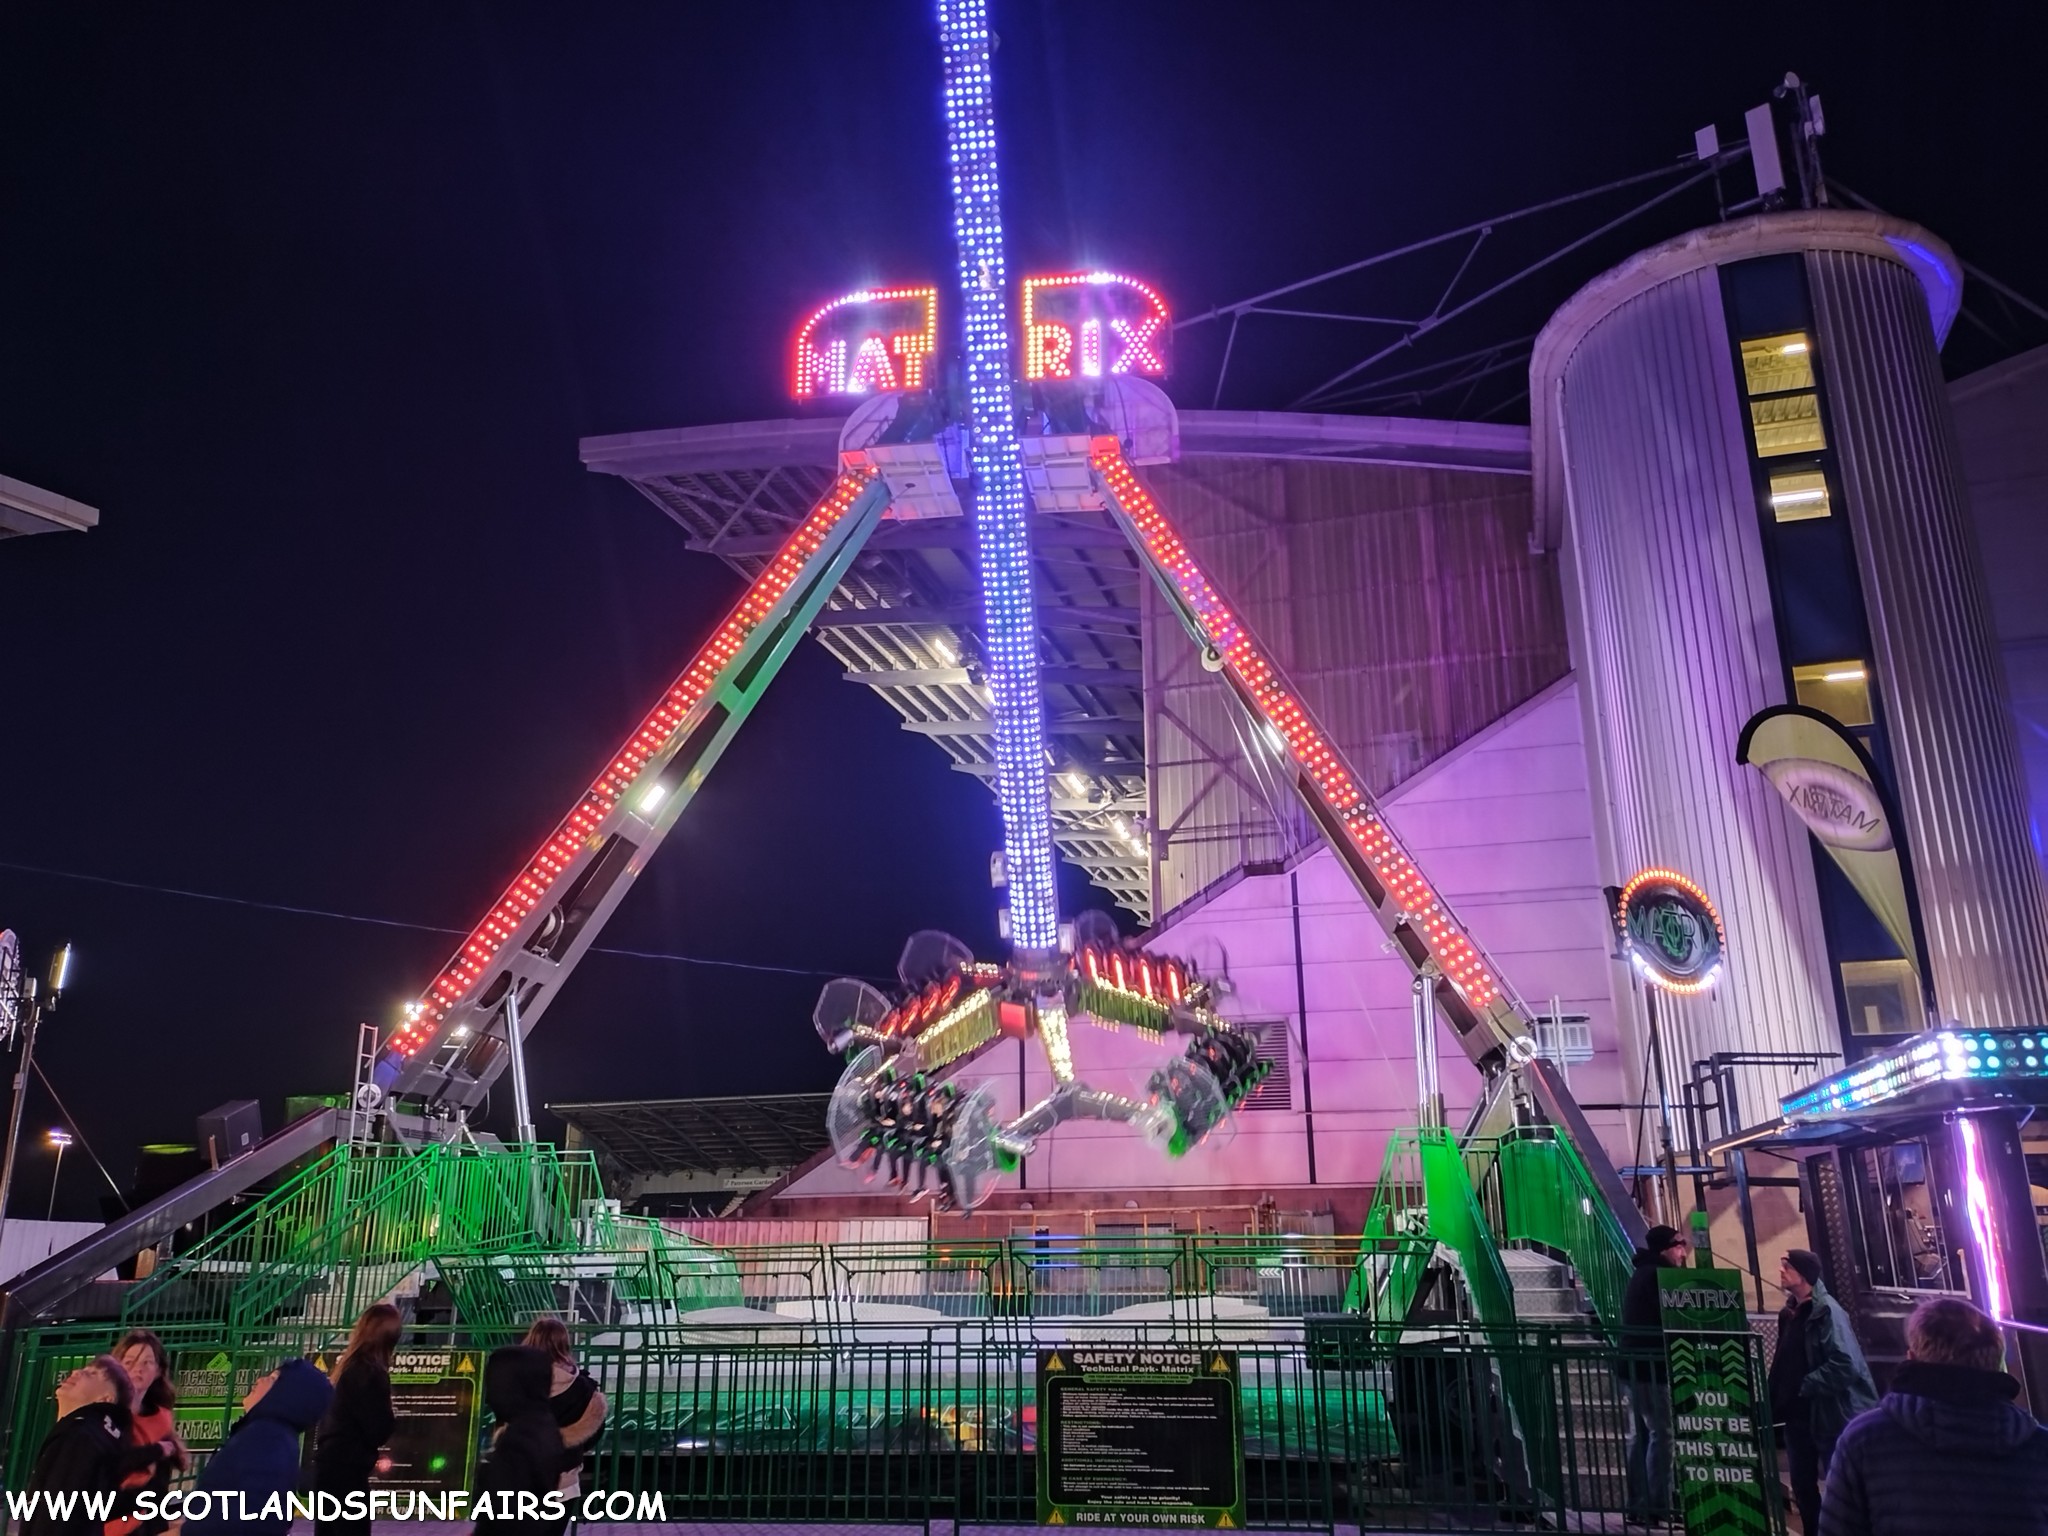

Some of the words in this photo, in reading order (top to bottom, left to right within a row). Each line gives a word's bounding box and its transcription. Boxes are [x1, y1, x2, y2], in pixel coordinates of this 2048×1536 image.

[1627, 903, 1720, 953] MATRIX
[1661, 1288, 1739, 1309] MATRIX
[395, 1354, 451, 1366] NOTICE
[1073, 1353, 1135, 1365] SAFETY
[1140, 1353, 1202, 1365] NOTICE
[413, 1366, 443, 1374] Matrix
[1081, 1364, 1130, 1373] Technical
[1161, 1365, 1194, 1373] Matrix
[178, 1369, 227, 1386] TICKETS
[1695, 1392, 1728, 1406] YOU
[1678, 1416, 1723, 1431] MUST
[1728, 1417, 1750, 1432] BE
[1676, 1441, 1714, 1456] THIS
[1717, 1442, 1758, 1458] TALL
[1686, 1467, 1708, 1481] TO
[1714, 1468, 1754, 1483] RIDE
[1076, 1512, 1101, 1522] RIDE
[1103, 1513, 1117, 1522] AT
[1119, 1513, 1149, 1523] YOUR
[1152, 1514, 1177, 1523] OWN
[1180, 1514, 1206, 1524] RISK
